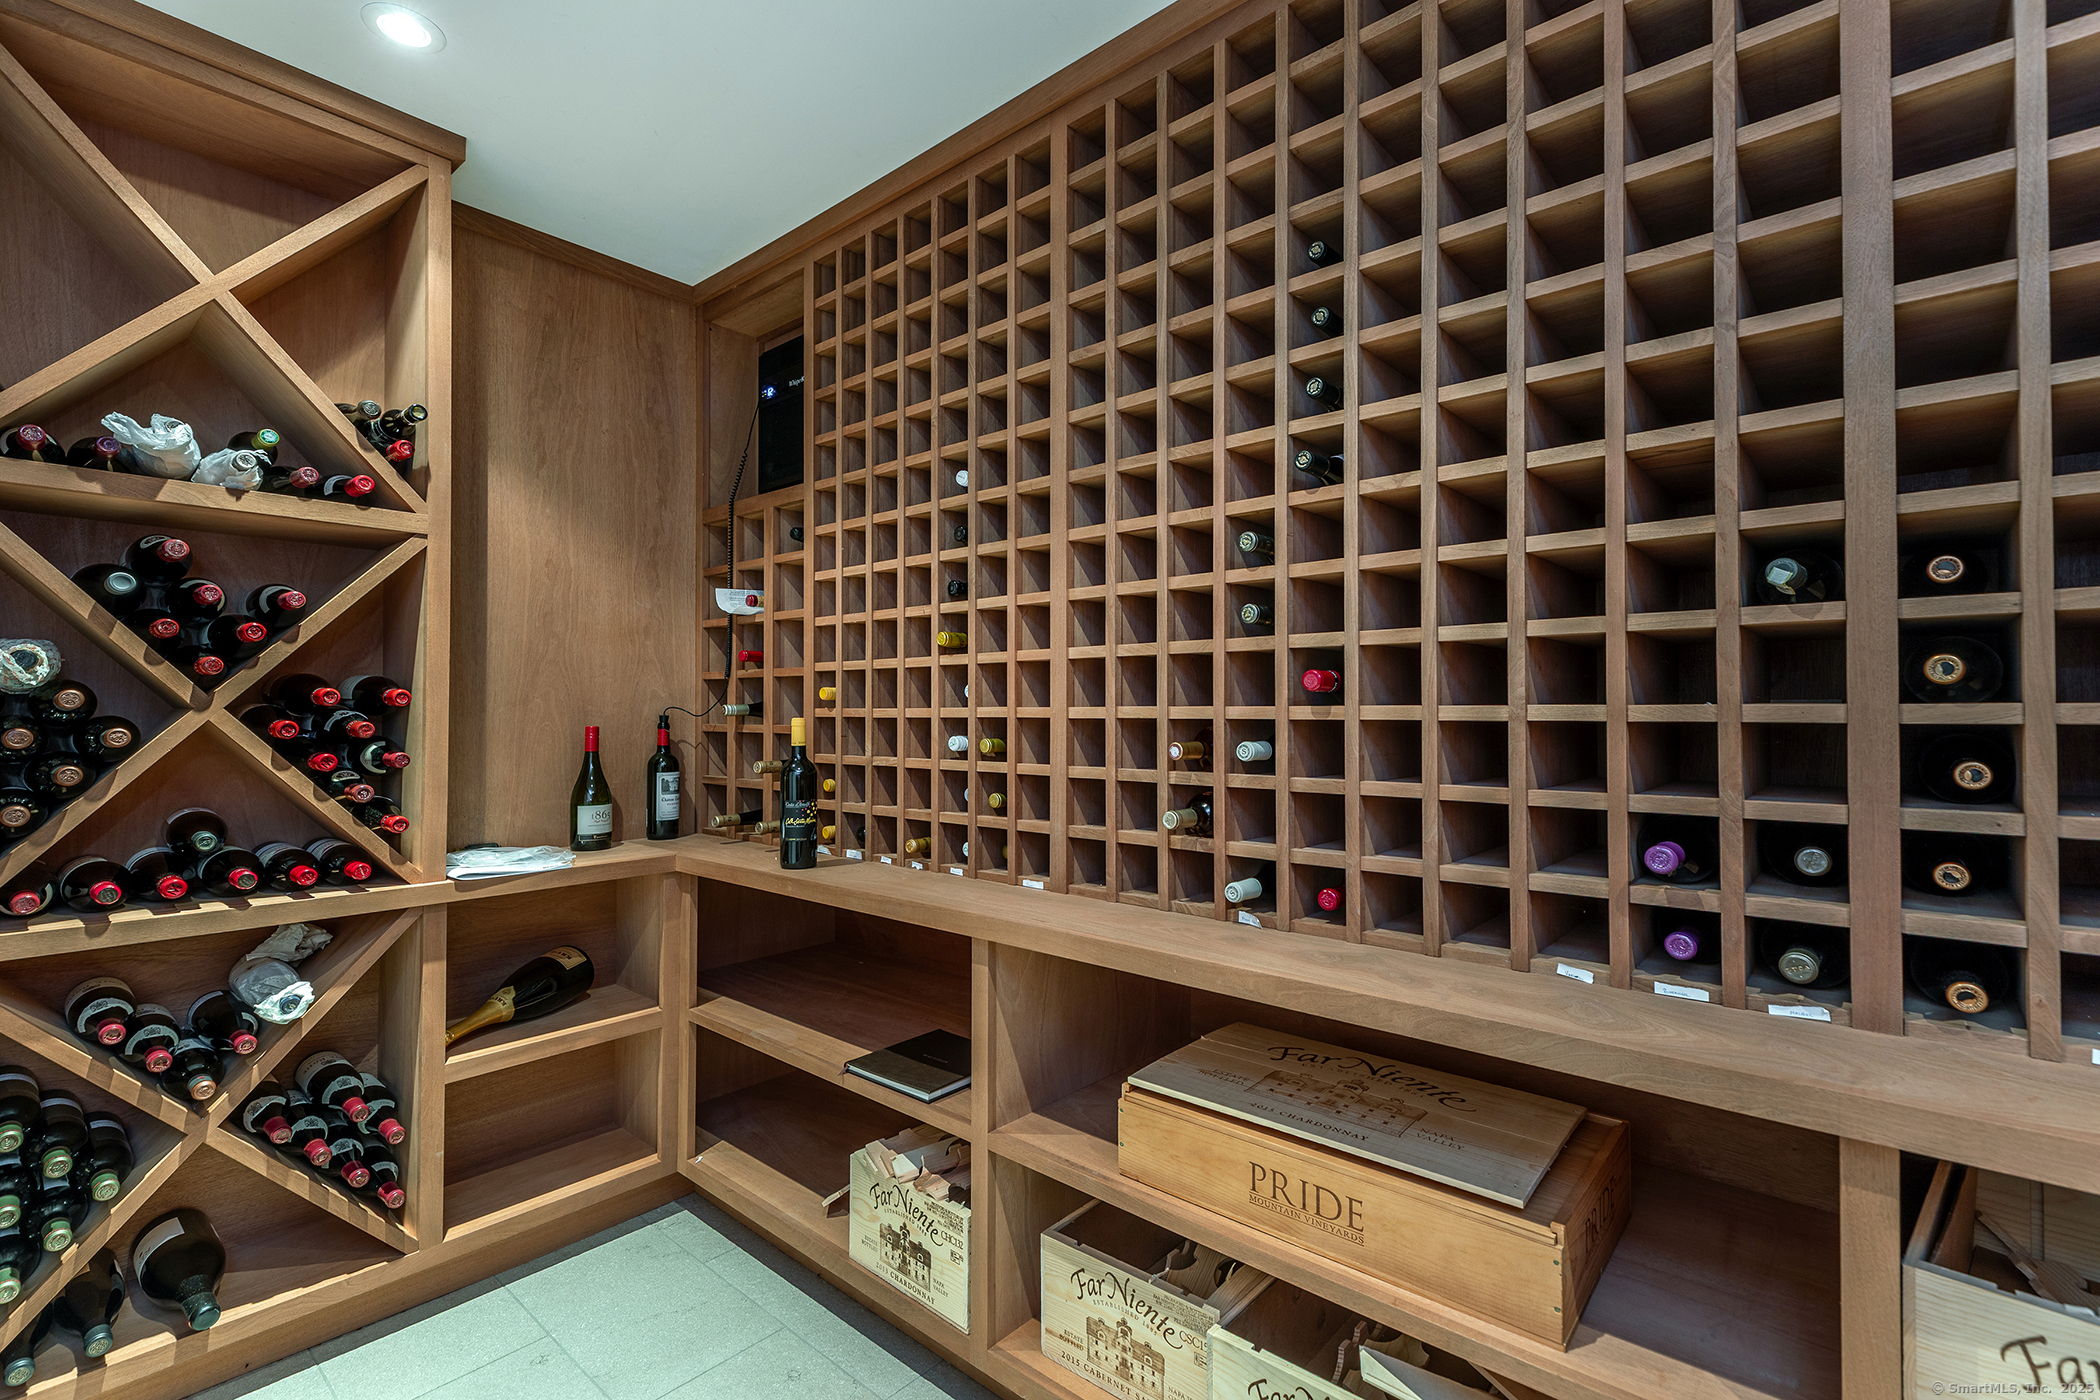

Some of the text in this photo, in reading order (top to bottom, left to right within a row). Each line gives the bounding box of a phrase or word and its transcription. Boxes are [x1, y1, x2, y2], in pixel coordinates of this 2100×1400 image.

[591, 809, 611, 820] 1865
[1267, 1046, 1477, 1113] Far Niente
[1279, 1110, 1369, 1141] CHARDONNAY
[1416, 1133, 1465, 1151] VALLEY
[1420, 1128, 1455, 1142] NAPA
[869, 1182, 893, 1210] Far
[893, 1184, 944, 1247] Niente
[1249, 1160, 1365, 1233] PRIDE
[1249, 1193, 1365, 1246] MOUNTAIN VINEYARDS
[1585, 1175, 1615, 1254] PRIDE
[890, 1270, 935, 1305] CHARDONNAY
[1070, 1267, 1106, 1300] Far
[1104, 1271, 1183, 1350] Niente
[1061, 1351, 1132, 1396] 2015 CABERNET
